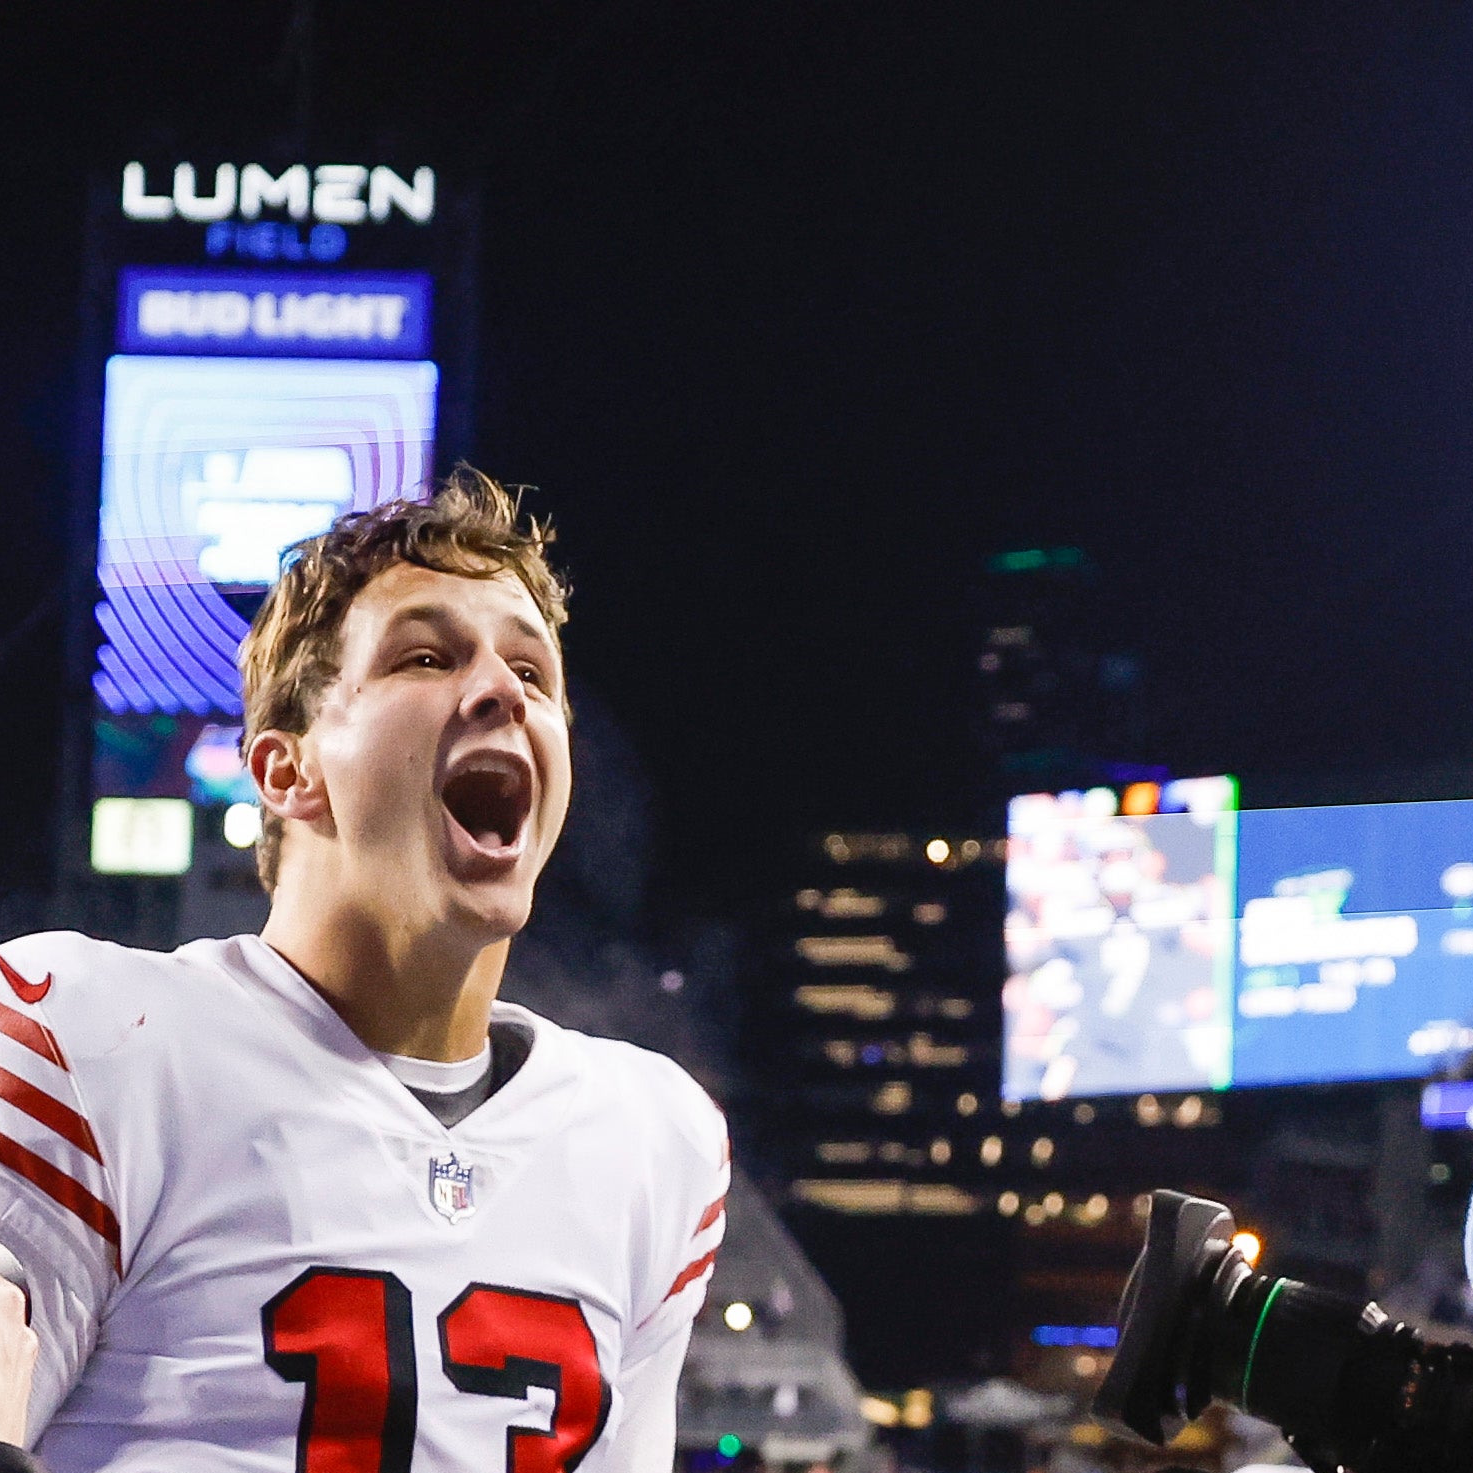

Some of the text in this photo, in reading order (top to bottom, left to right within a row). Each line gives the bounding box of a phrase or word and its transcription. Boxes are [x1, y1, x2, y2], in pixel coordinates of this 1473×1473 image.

[122, 161, 435, 224] LUMEN
[205, 220, 348, 262] FIELD
[138, 290, 408, 340] BUD LIGHT
